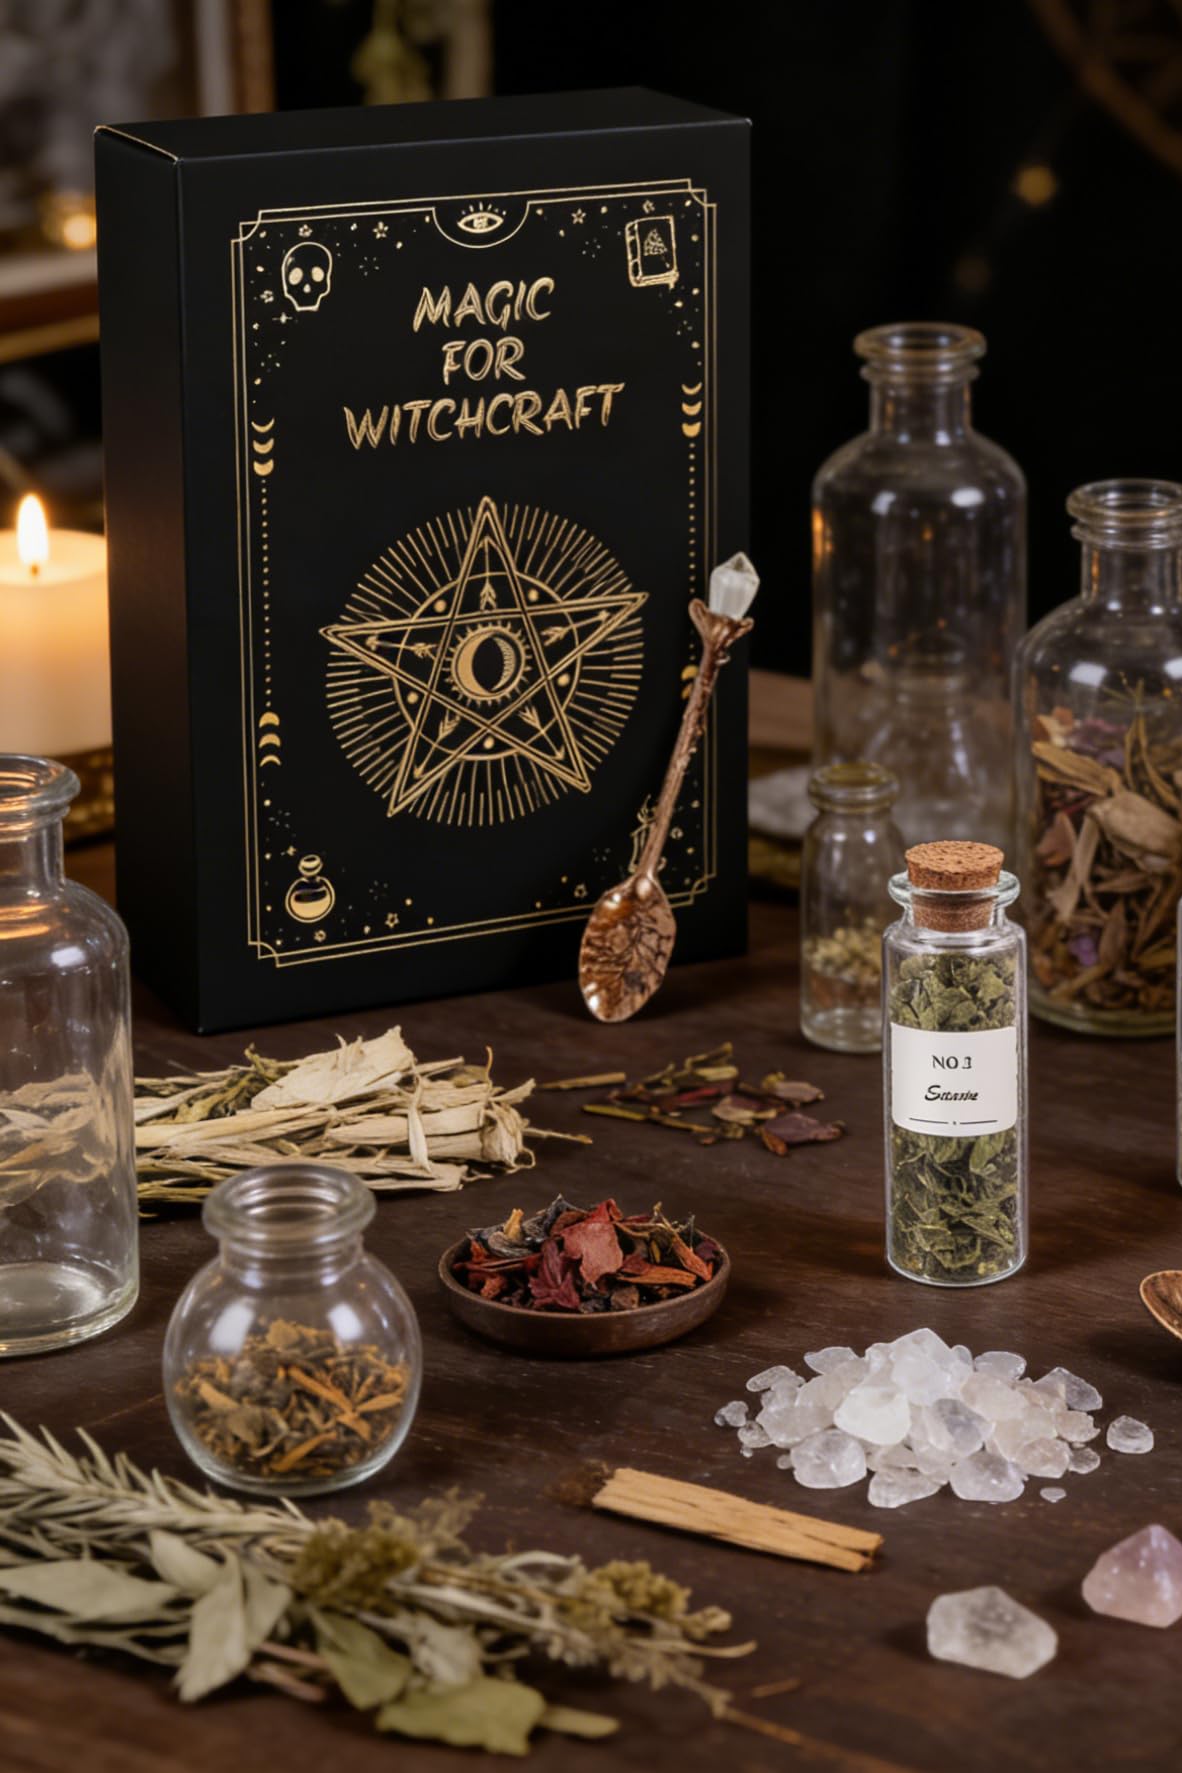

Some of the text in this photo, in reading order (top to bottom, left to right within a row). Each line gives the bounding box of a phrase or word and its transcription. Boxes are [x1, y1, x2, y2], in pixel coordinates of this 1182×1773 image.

[412, 276, 555, 333] MAGIC
[441, 335, 526, 385] FOR
[343, 381, 625, 450] WITCHCRAFT
